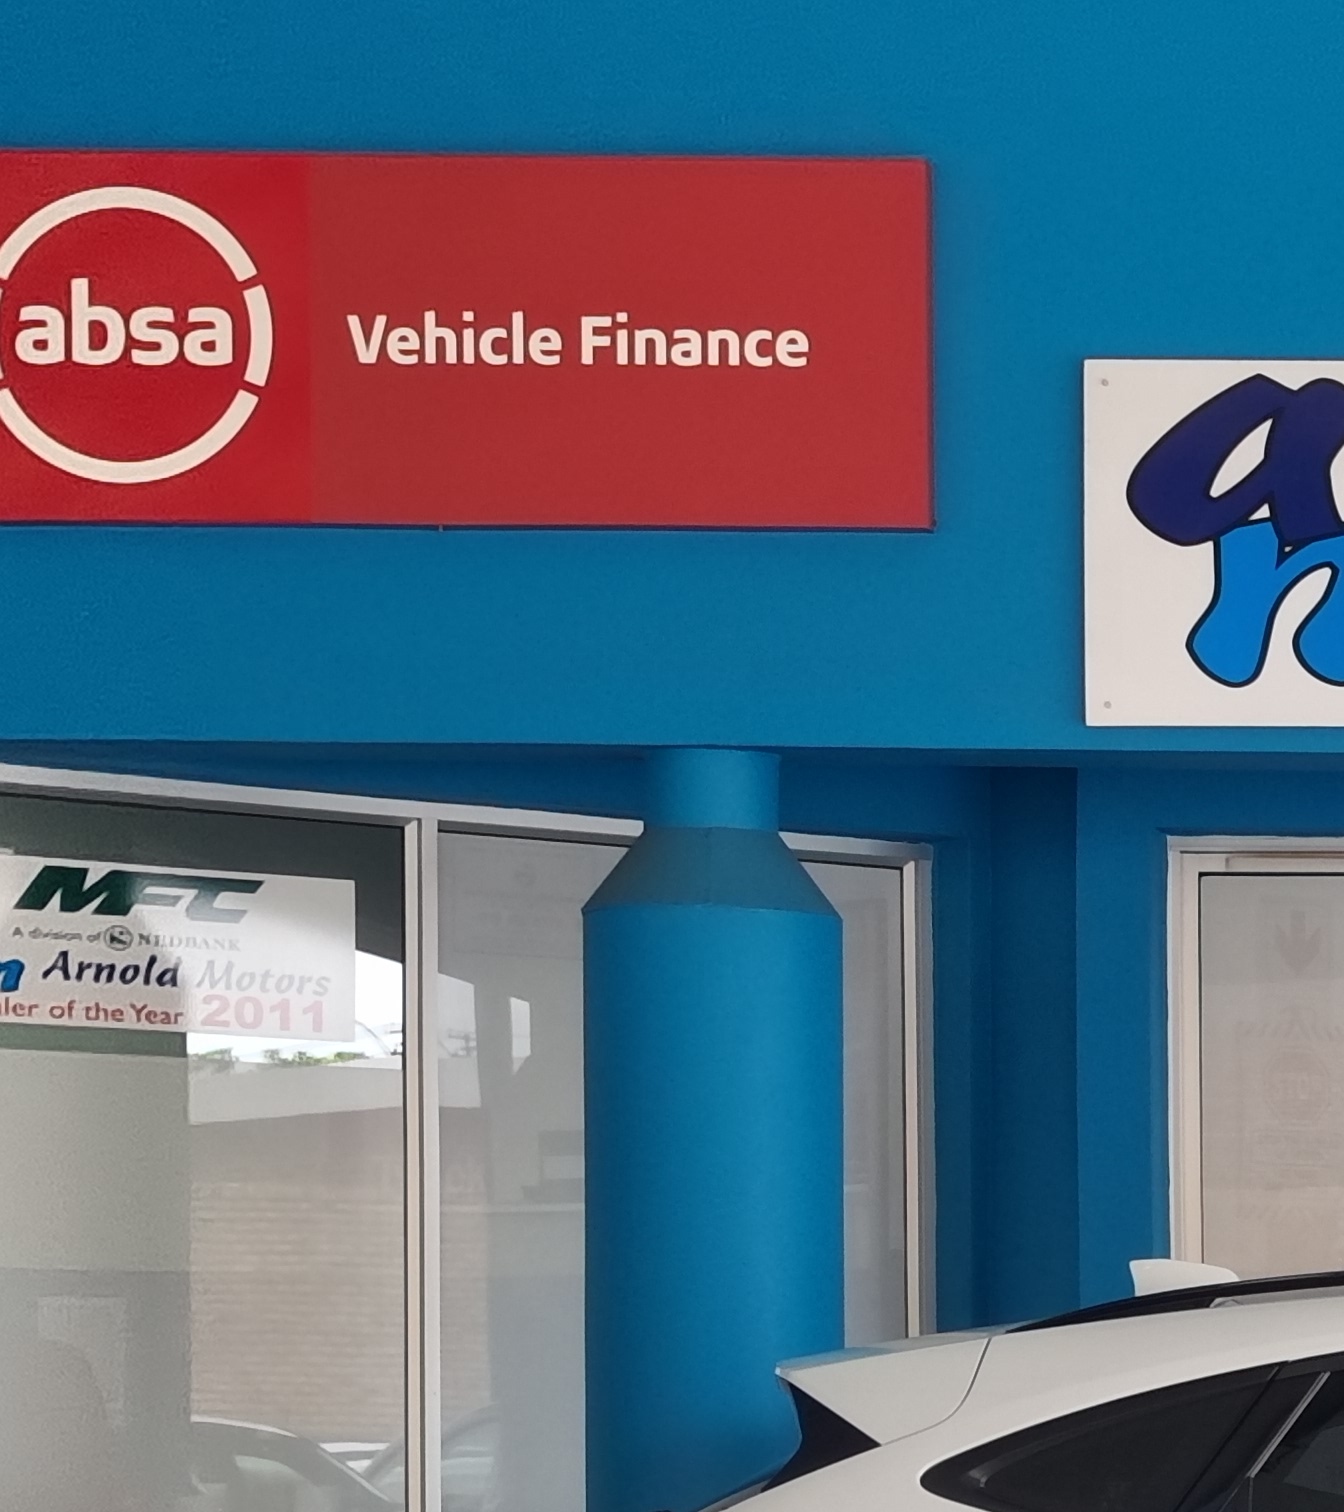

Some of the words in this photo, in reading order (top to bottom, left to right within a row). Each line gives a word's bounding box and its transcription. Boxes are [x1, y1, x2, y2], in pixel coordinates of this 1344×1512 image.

[14, 278, 233, 366] absa
[346, 309, 562, 366] Vehicle
[580, 309, 810, 368] Finance
[13, 864, 265, 924] MFC
[137, 932, 241, 951] NEDBANK
[41, 950, 183, 989] Arnold
[195, 959, 331, 998] Motors
[49, 999, 77, 1020] of
[84, 1002, 125, 1023] the
[130, 1002, 184, 1025] Year
[200, 993, 324, 1033] 2011
